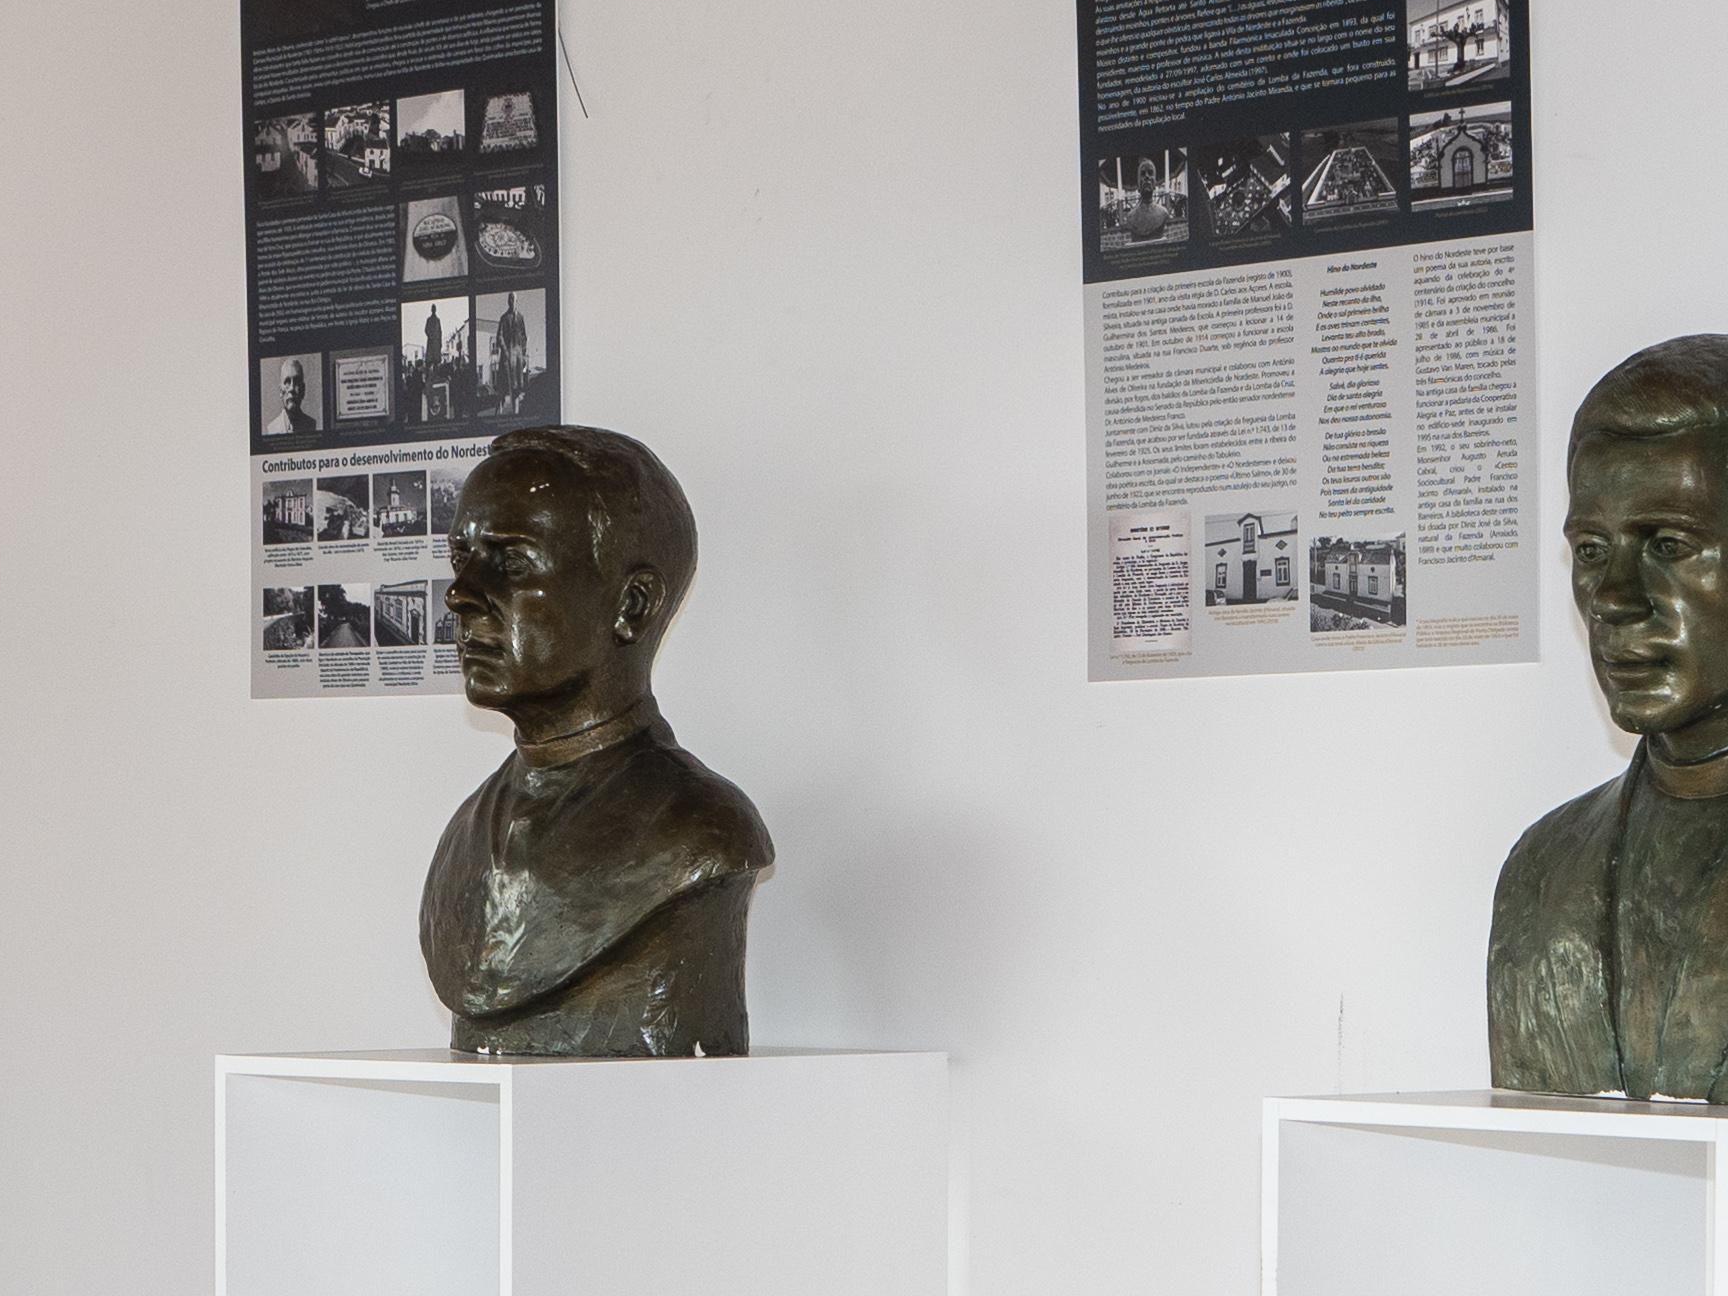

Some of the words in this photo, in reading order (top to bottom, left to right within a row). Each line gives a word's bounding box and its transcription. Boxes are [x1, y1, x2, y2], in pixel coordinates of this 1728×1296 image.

[261, 457, 316, 474] Contributos
[318, 456, 340, 472] para
[340, 456, 348, 467] o
[349, 448, 434, 466] desenvolvimento
[435, 445, 449, 460] do
[450, 440, 493, 460] Nordest
